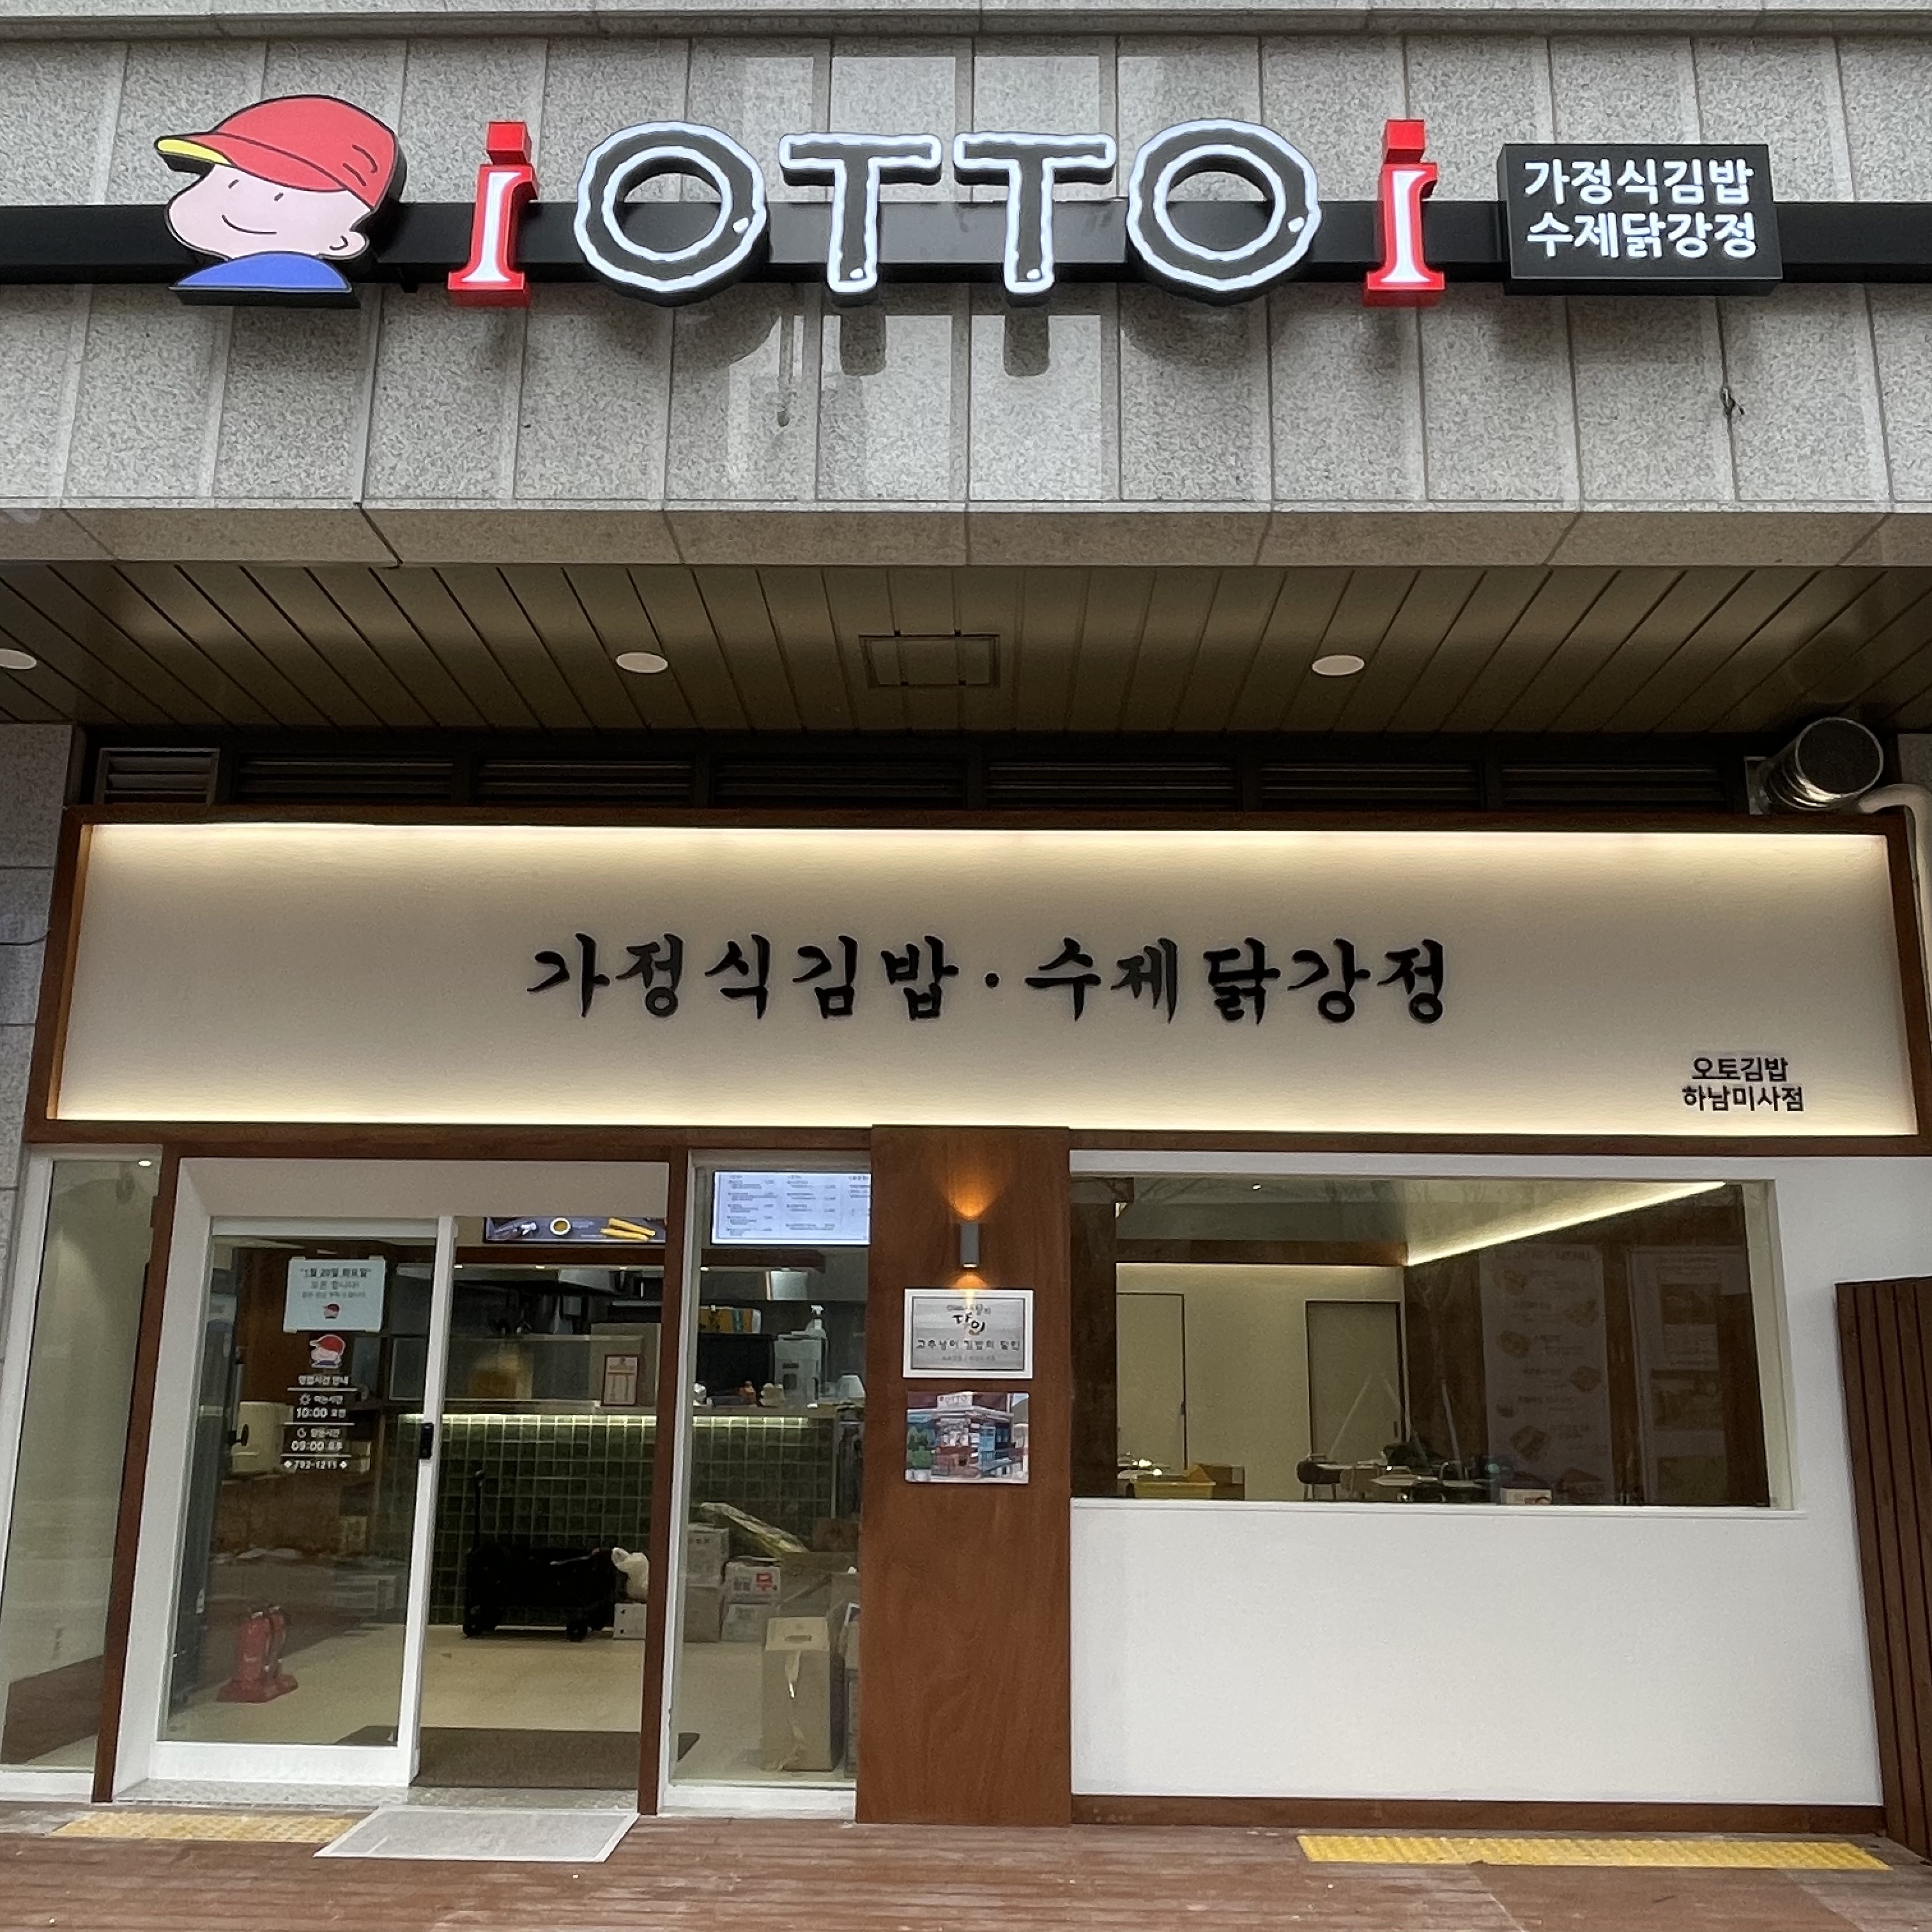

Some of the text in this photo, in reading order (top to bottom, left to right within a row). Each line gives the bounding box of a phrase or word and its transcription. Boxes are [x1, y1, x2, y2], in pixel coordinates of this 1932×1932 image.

[1524, 158, 1754, 205] 가정식김밥
[1526, 211, 1758, 259] 수제닭강정
[526, 932, 1445, 1026] 가정식김밥 수제닭강정
[1692, 1057, 1789, 1082] 오토김밥
[1682, 1085, 1804, 1112] 하남미사점
[296, 1407, 328, 1418] 10:00
